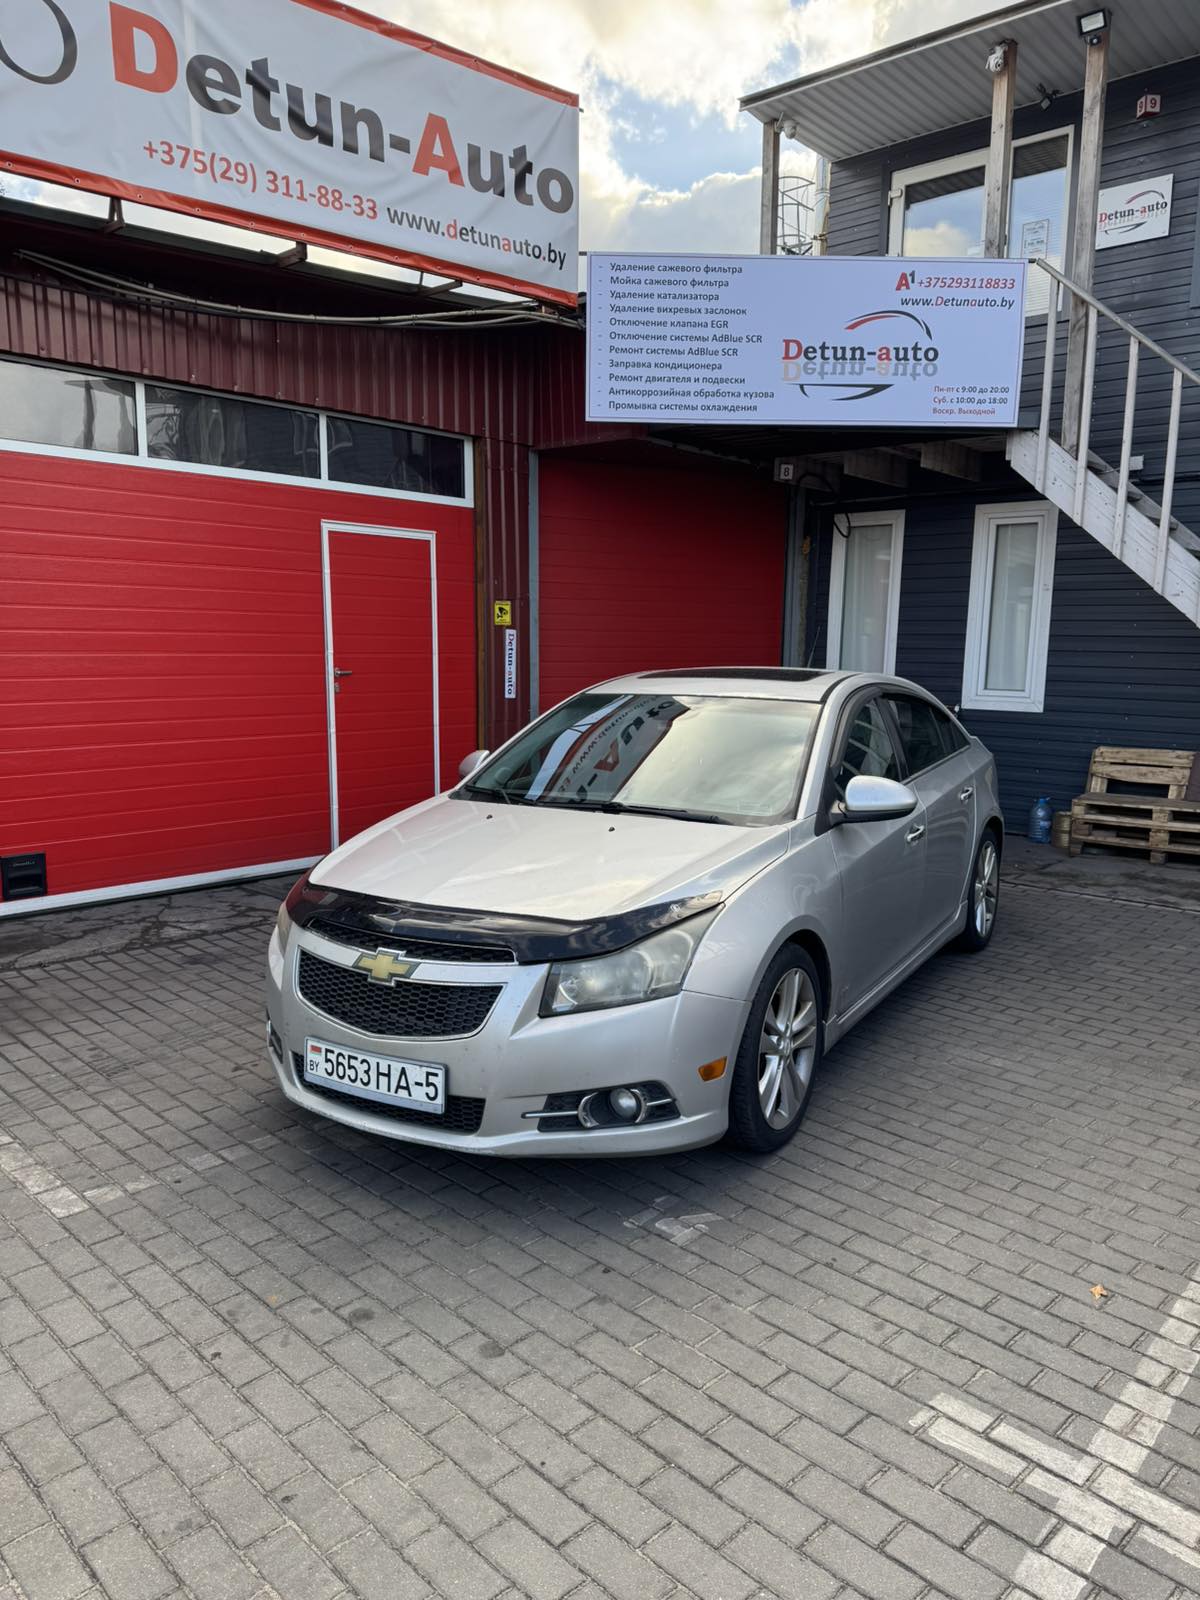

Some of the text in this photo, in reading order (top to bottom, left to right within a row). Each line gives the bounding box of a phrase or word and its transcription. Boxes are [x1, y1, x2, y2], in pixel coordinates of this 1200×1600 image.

[109, 1, 574, 214] Detun-Auto
[143, 141, 566, 270] +375(29) 311-88-33 www.detunauto.by
[1099, 201, 1168, 223] Detun-auto
[610, 262, 743, 275] Удаление сажевого фильтра
[610, 276, 729, 288] Мойка сажевого фильтра
[918, 277, 1015, 290] +375293118833
[610, 290, 719, 302] Удаление катализатора
[900, 296, 1015, 310] www.Detunauto.by
[609, 304, 655, 314] Удаление
[657, 306, 702, 315] вихревых
[609, 317, 729, 329] Отключение клапана EGR
[609, 331, 762, 343] Отключение системы AdBlue SCR
[609, 345, 644, 354] Ремонт
[687, 347, 719, 356] AdBlue
[721, 348, 738, 356] SCR
[782, 338, 939, 362] Detun-auto
[609, 359, 722, 371] Заправка кондиционера
[609, 373, 643, 382] Ремонт
[645, 376, 692, 384] двигателя
[702, 377, 745, 385] подвески
[609, 387, 775, 400] Антикоррозийная обработка кузова
[609, 401, 758, 412] Промывка системы охлаждения
[309, 1060, 320, 1072] BY
